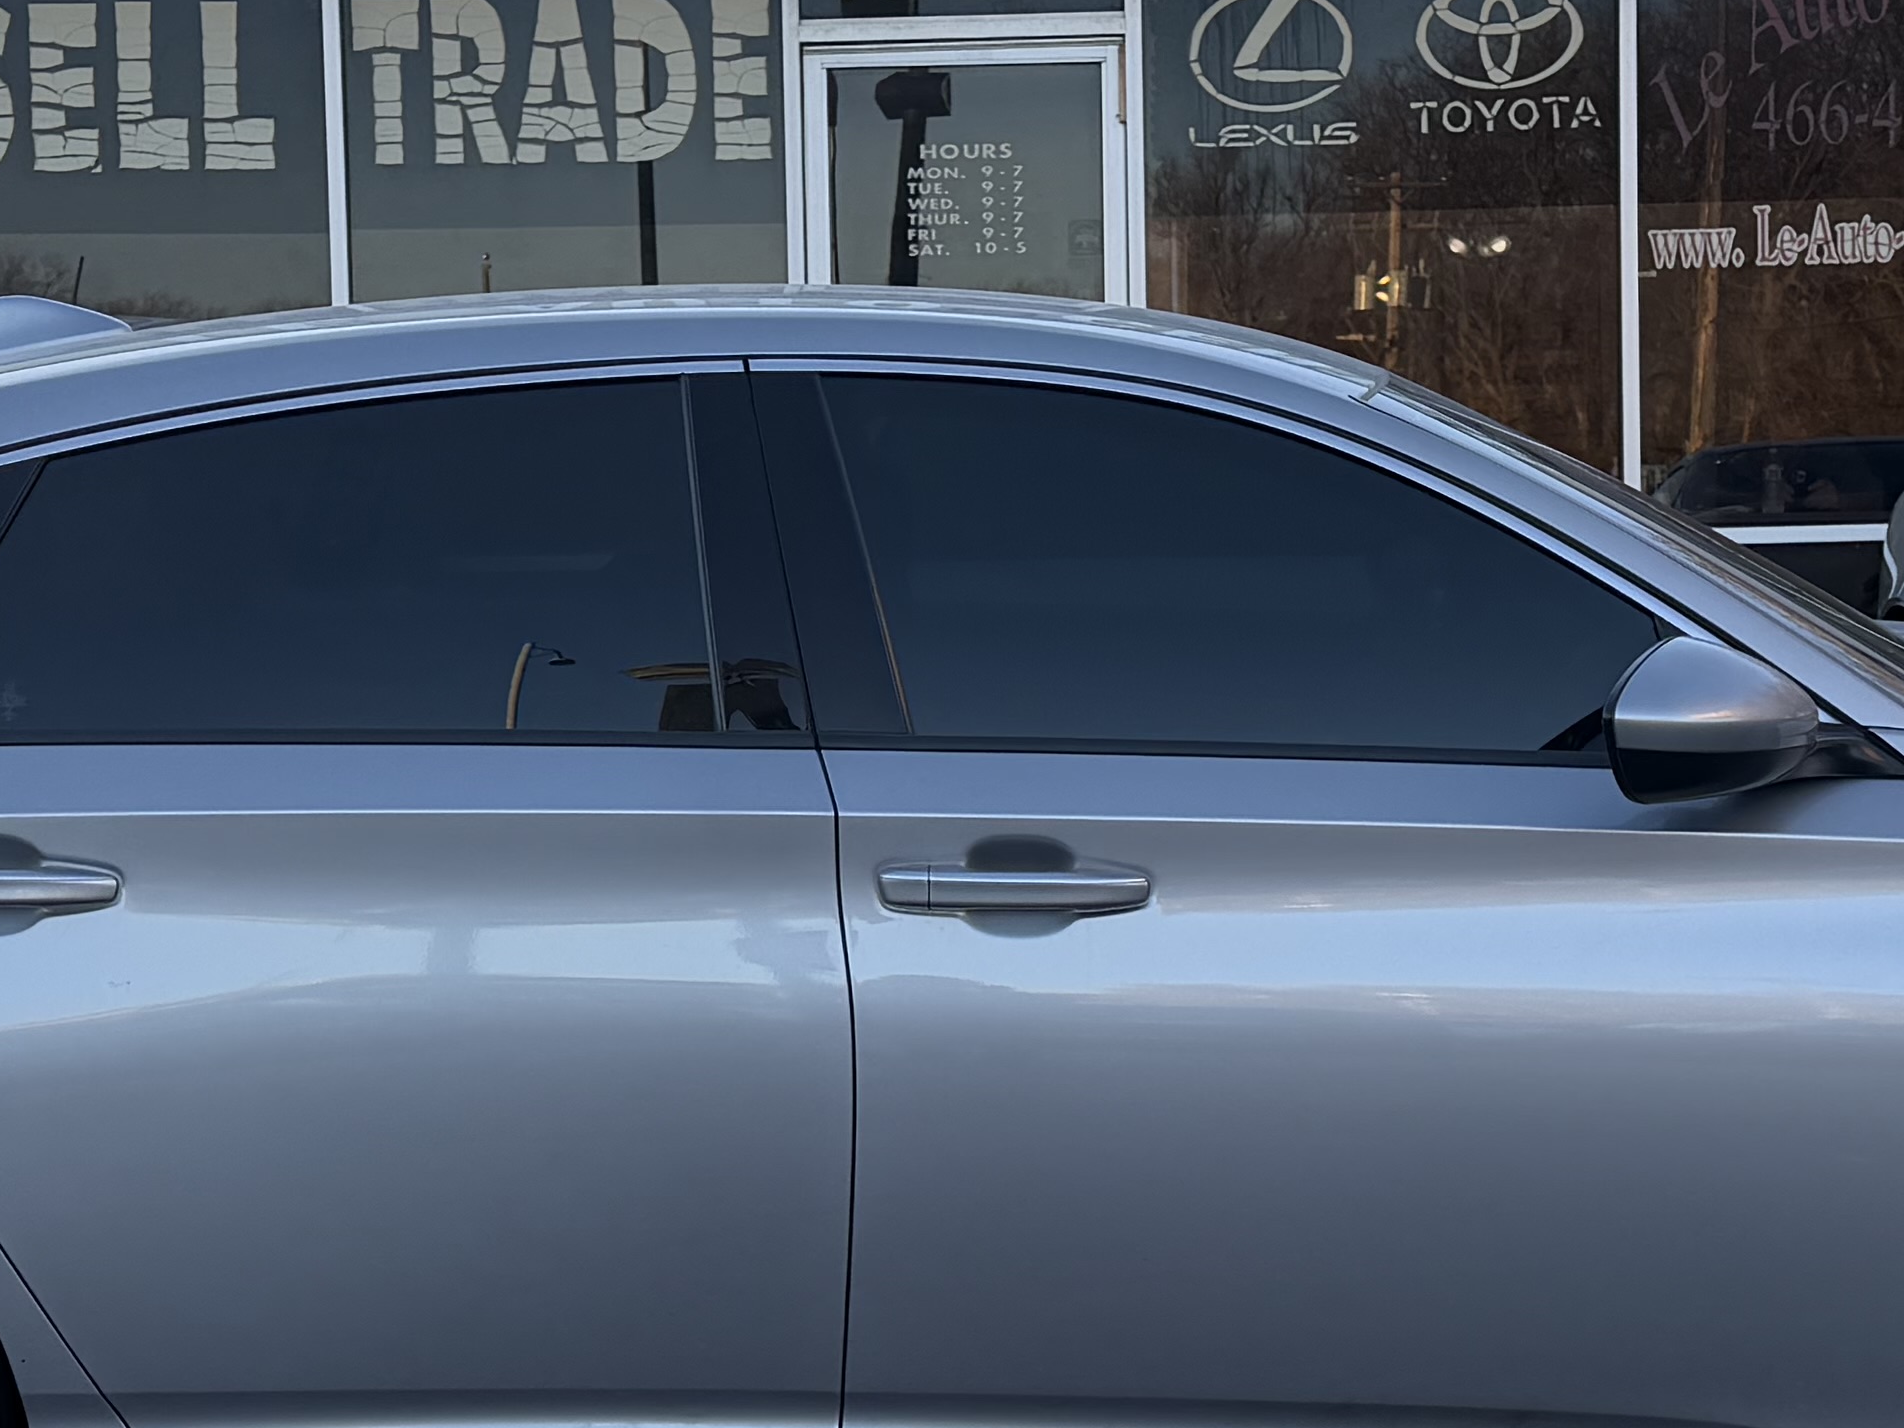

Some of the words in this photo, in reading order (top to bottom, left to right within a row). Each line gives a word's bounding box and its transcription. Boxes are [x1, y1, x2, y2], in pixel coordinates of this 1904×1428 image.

[1649, 50, 1733, 155] Le
[1409, 95, 1602, 134] TOYOTA
[1188, 121, 1360, 148] LEXUS
[919, 143, 1013, 160] HOURS
[907, 167, 966, 179] MON.
[907, 182, 949, 194] TUE.
[907, 198, 959, 210] WED.
[907, 213, 969, 225] THUR.
[907, 228, 936, 241] FRI
[908, 244, 950, 257] SAT.
